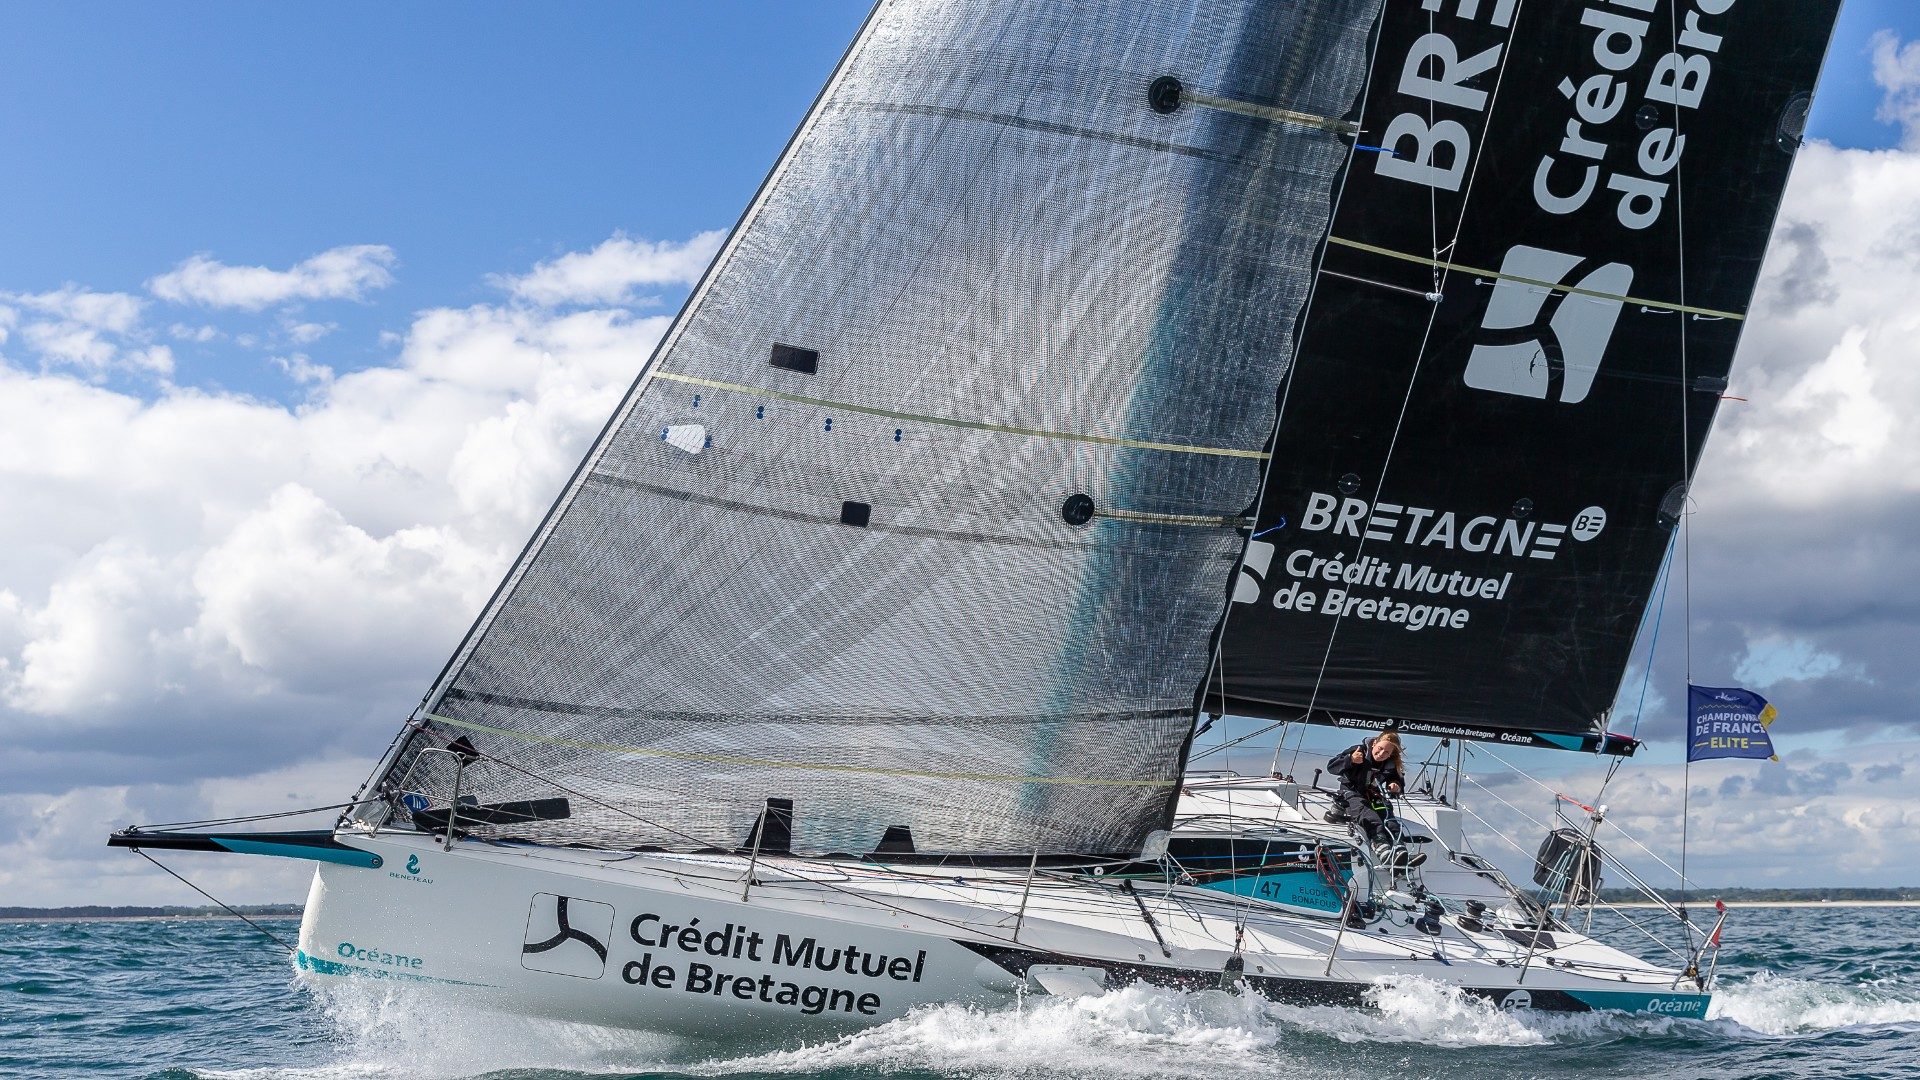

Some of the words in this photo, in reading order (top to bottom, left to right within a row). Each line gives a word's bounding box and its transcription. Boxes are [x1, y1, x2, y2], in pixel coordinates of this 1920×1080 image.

[1607, 128, 1686, 230] de
[1300, 492, 1567, 560] BRETAGNE
[1285, 549, 1392, 588] Crédit
[1393, 563, 1513, 600] Mutuel
[1272, 582, 1317, 612] de
[1320, 588, 1470, 631] Bretagne
[1339, 718, 1386, 730] BRETAGNE
[1410, 723, 1431, 732] Crédit
[1431, 725, 1456, 735] Mutuel
[1465, 729, 1496, 739] Bretagne
[1696, 723, 1709, 736] DE
[1501, 732, 1533, 744] Océane
[1711, 737, 1749, 749] ELITE
[389, 872, 434, 884] BENETEAU
[1261, 880, 1282, 898] 47
[1291, 894, 1337, 909] BONAFOUS
[337, 942, 423, 970] Océane
[629, 913, 765, 962] Crédit
[771, 933, 927, 983] Mutuel
[621, 953, 676, 989] de
[685, 962, 881, 1015] Bretagne
[1647, 998, 1702, 1013] Océane
